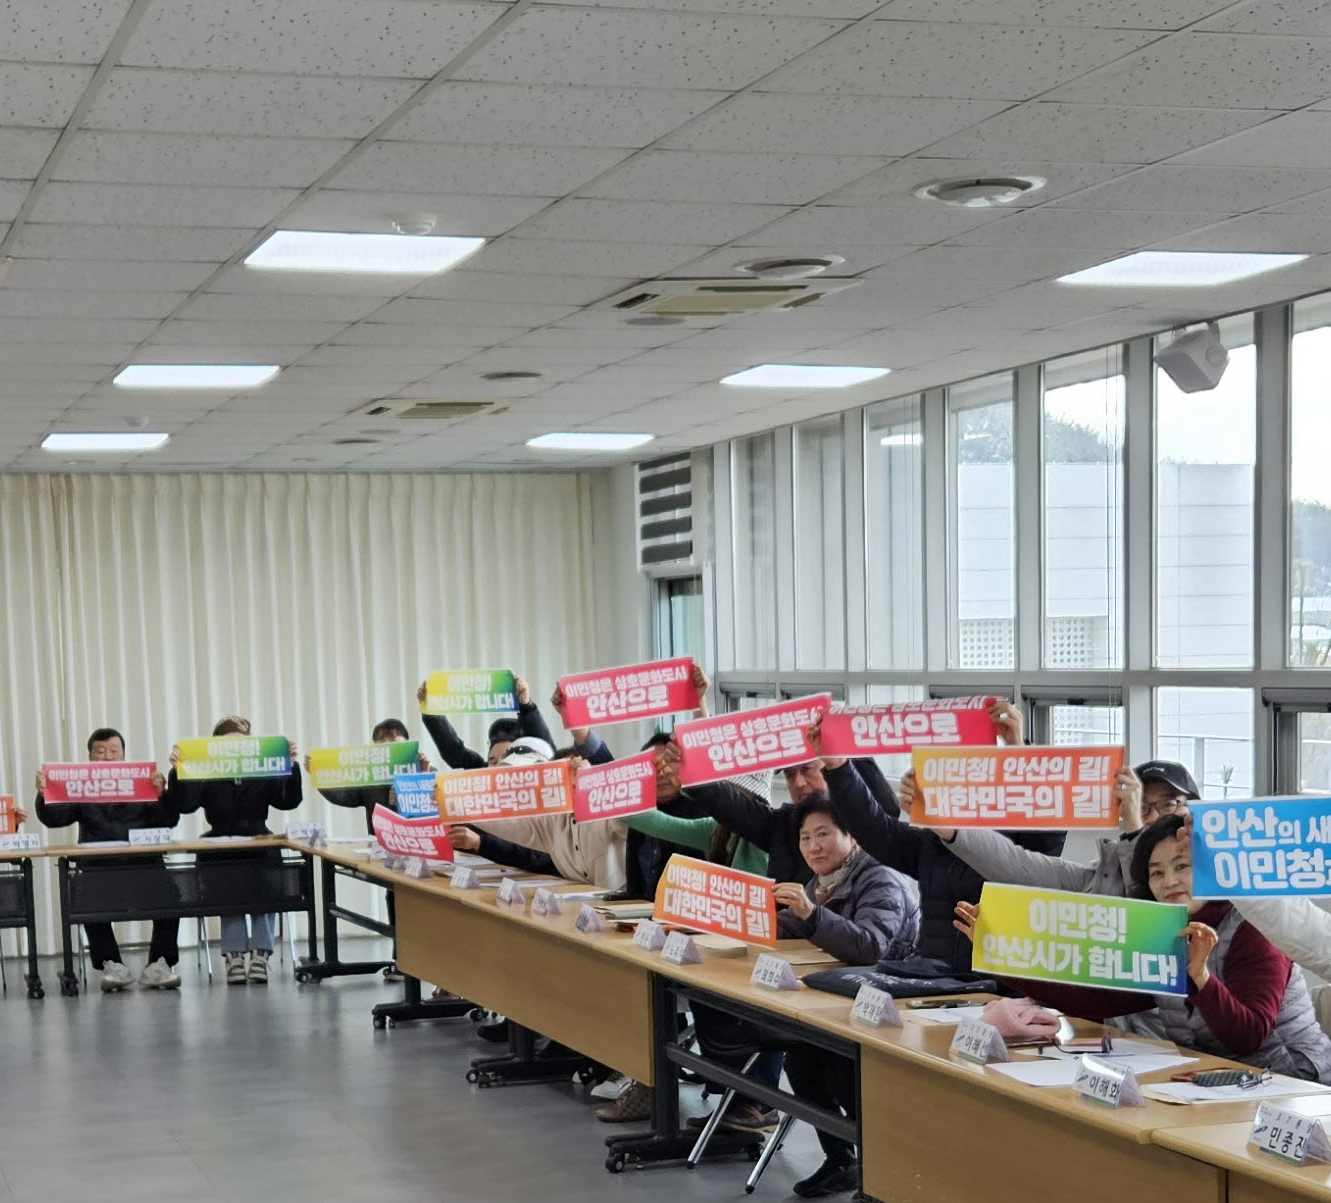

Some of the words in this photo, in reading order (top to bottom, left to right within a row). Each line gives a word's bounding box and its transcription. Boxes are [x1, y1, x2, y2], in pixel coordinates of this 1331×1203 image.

[565, 677, 613, 698] 이민청은
[614, 666, 688, 691] 상호문화도시
[586, 684, 669, 719] 안산으로
[681, 723, 738, 750] 이민청은
[850, 712, 962, 748] 안산으로
[707, 728, 806, 772] 안산으로
[443, 775, 491, 795] 이민청!
[495, 770, 540, 789] 안산의
[543, 767, 563, 786] 길!
[922, 757, 997, 783] 이민청!
[1002, 756, 1072, 783] 안산의
[1078, 756, 1111, 783] 길!
[65, 779, 135, 798] 안산으로
[445, 789, 538, 817] 대한민국의
[540, 785, 566, 807] 길!
[587, 780, 642, 814] 안산으로
[923, 785, 1065, 819] 대한민국의
[1071, 785, 1110, 819] 길!
[382, 831, 439, 856] 안산으로
[1201, 806, 1301, 849] 안산의
[667, 863, 707, 893] 이민청!
[709, 874, 746, 904] 안산의
[749, 884, 767, 909] 길!
[662, 887, 743, 933] 대한민국의
[746, 908, 770, 939] 길!
[1028, 897, 1127, 944] 이민청!
[982, 933, 1083, 976] 안산시가
[1088, 945, 1178, 987] 합니다!
